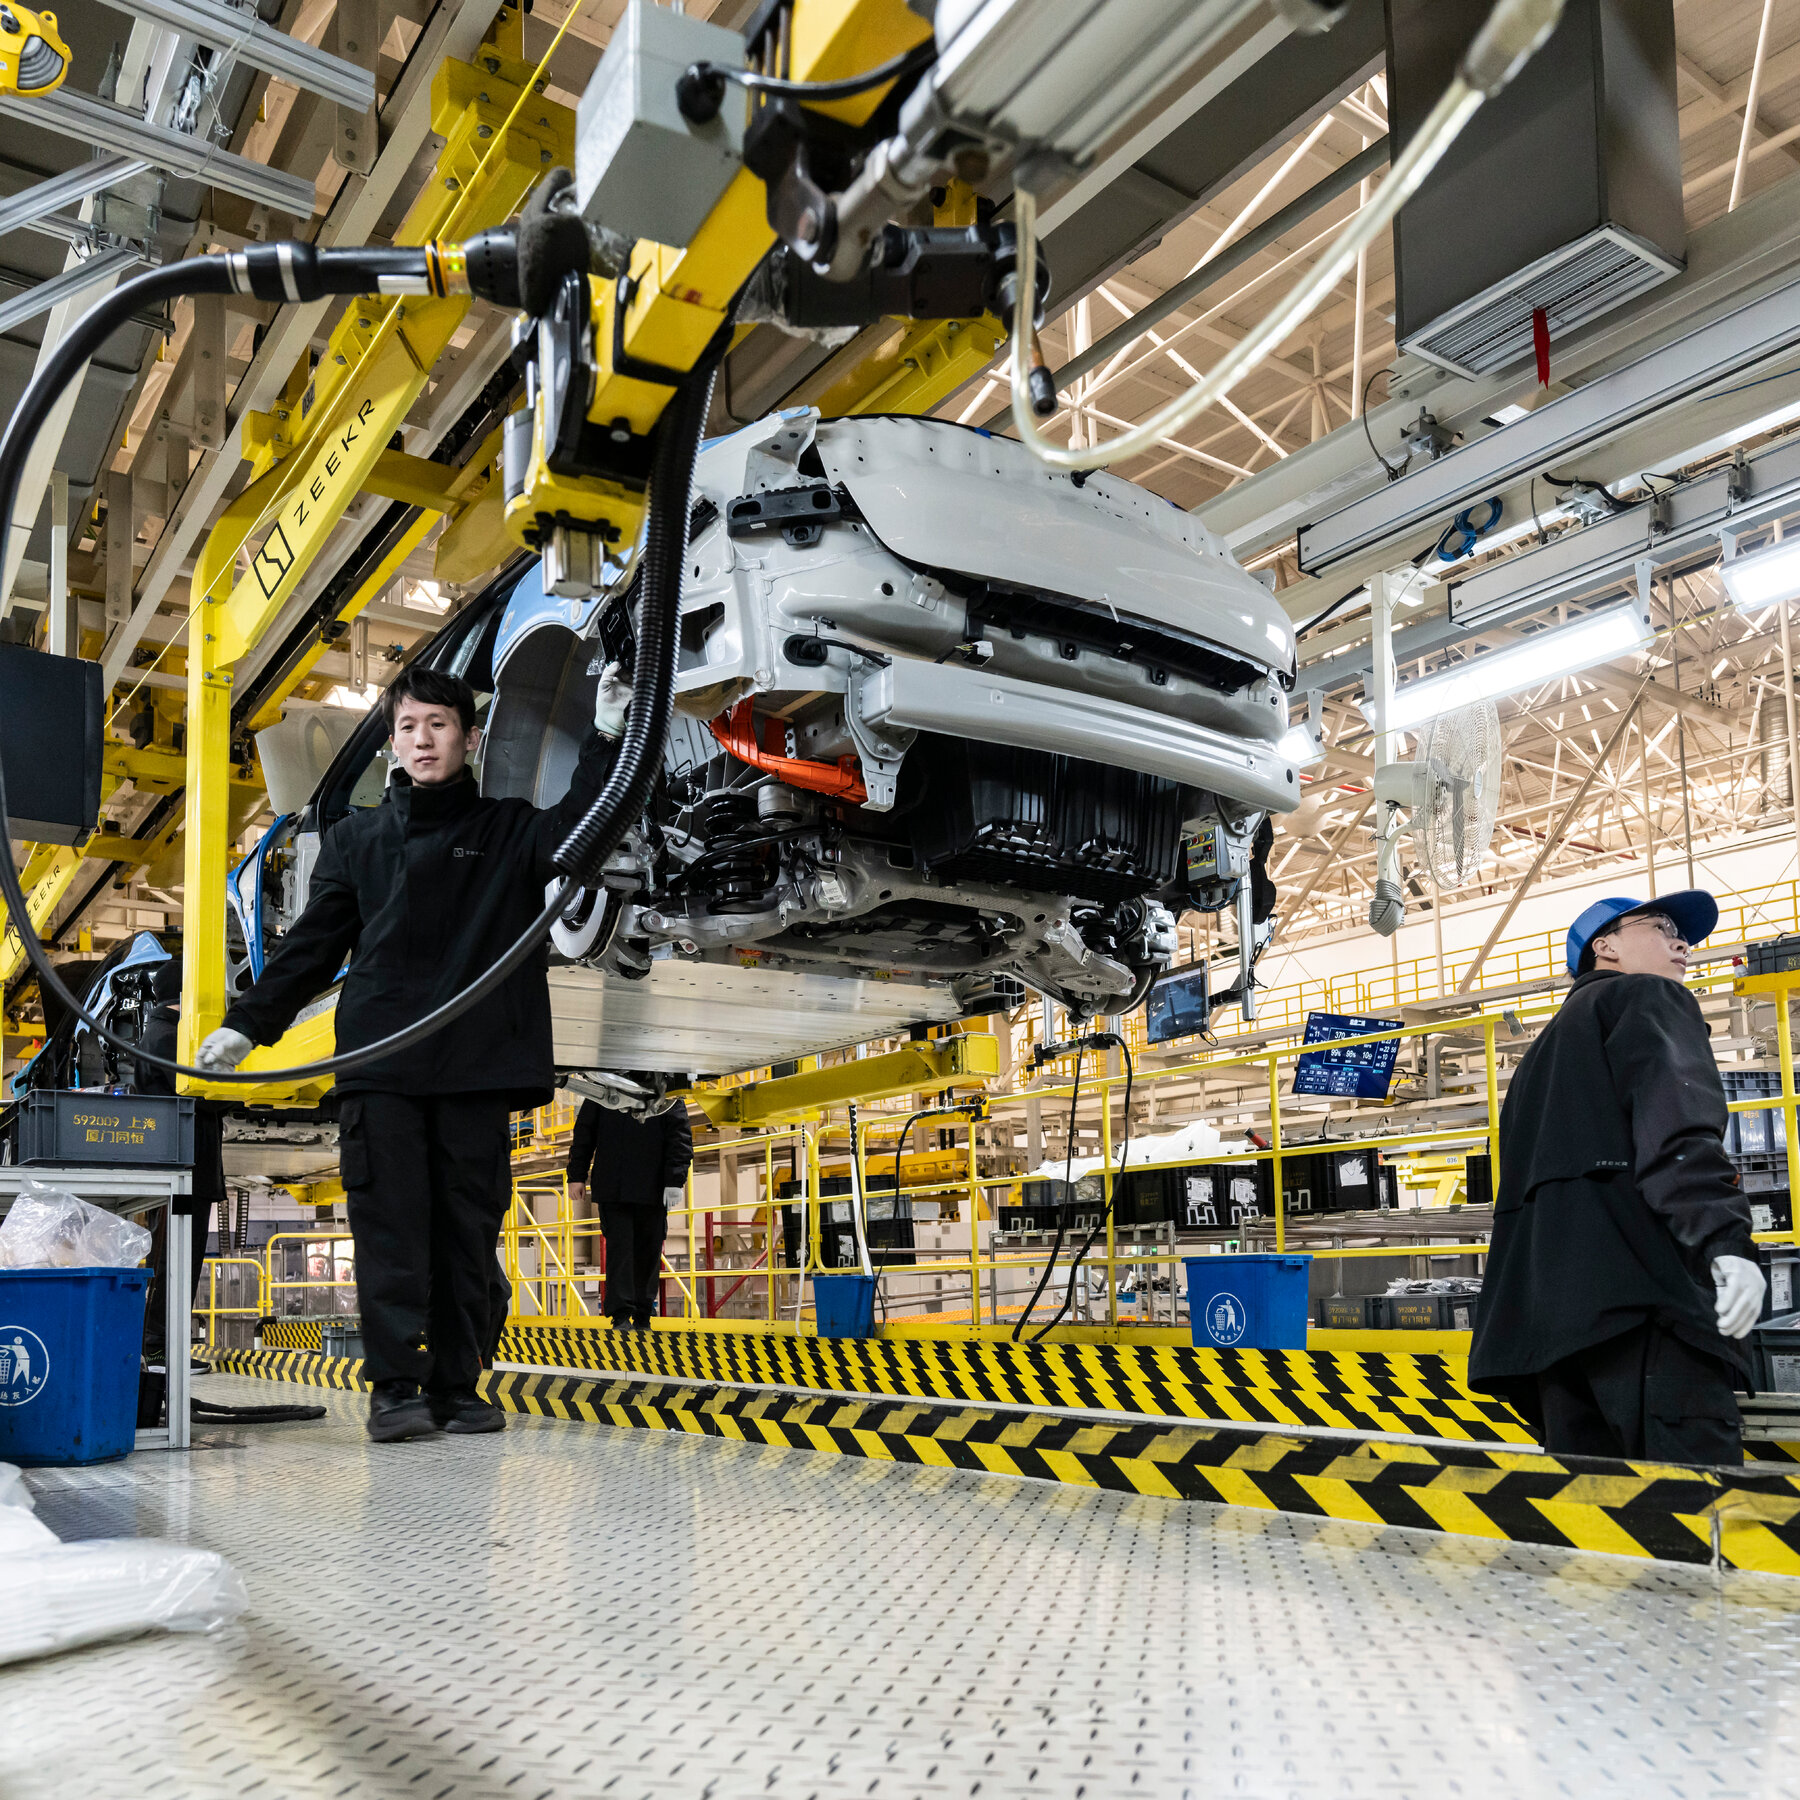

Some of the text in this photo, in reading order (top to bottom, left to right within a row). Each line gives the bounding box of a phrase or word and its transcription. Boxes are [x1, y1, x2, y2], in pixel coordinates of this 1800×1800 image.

[293, 398, 375, 528] ZEEKR
[72, 1114, 157, 1131] 592009 上海
